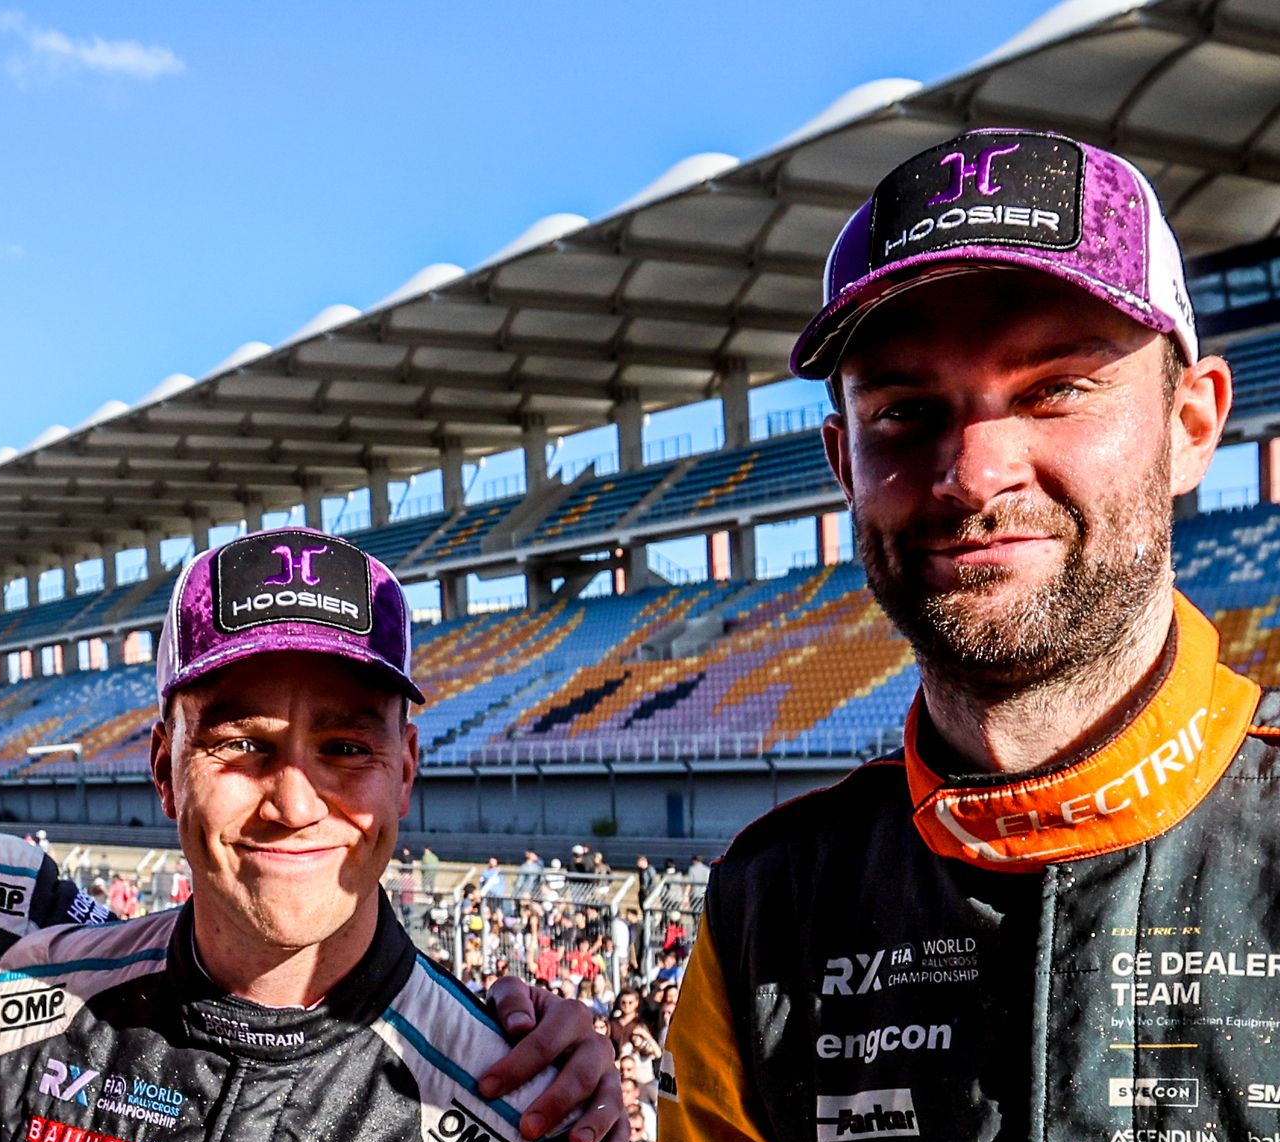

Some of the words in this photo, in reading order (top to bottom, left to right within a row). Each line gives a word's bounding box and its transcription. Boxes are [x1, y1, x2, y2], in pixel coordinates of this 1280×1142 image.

[885, 205, 1060, 257] HOOSIER
[233, 590, 359, 619] HOOSIER
[922, 937, 977, 955] WORLD
[822, 950, 885, 995] RX
[921, 955, 979, 967] RALLYCROSS
[1112, 952, 1153, 977] CE
[888, 968, 979, 986] CHAMPIONSHIP
[1, 988, 66, 1025] OMP
[1110, 981, 1201, 1007] TEAM
[206, 1021, 305, 1047] POWERTRAIN
[816, 1024, 953, 1065] engcon
[38, 1059, 101, 1107] RX
[133, 1078, 183, 1106] WORLD
[1118, 1085, 1191, 1098] SVECON
[96, 1098, 177, 1129] CHAMPIONSHIP
[127, 1095, 181, 1117] RALLYCROSS
[836, 1104, 915, 1137] Parker
